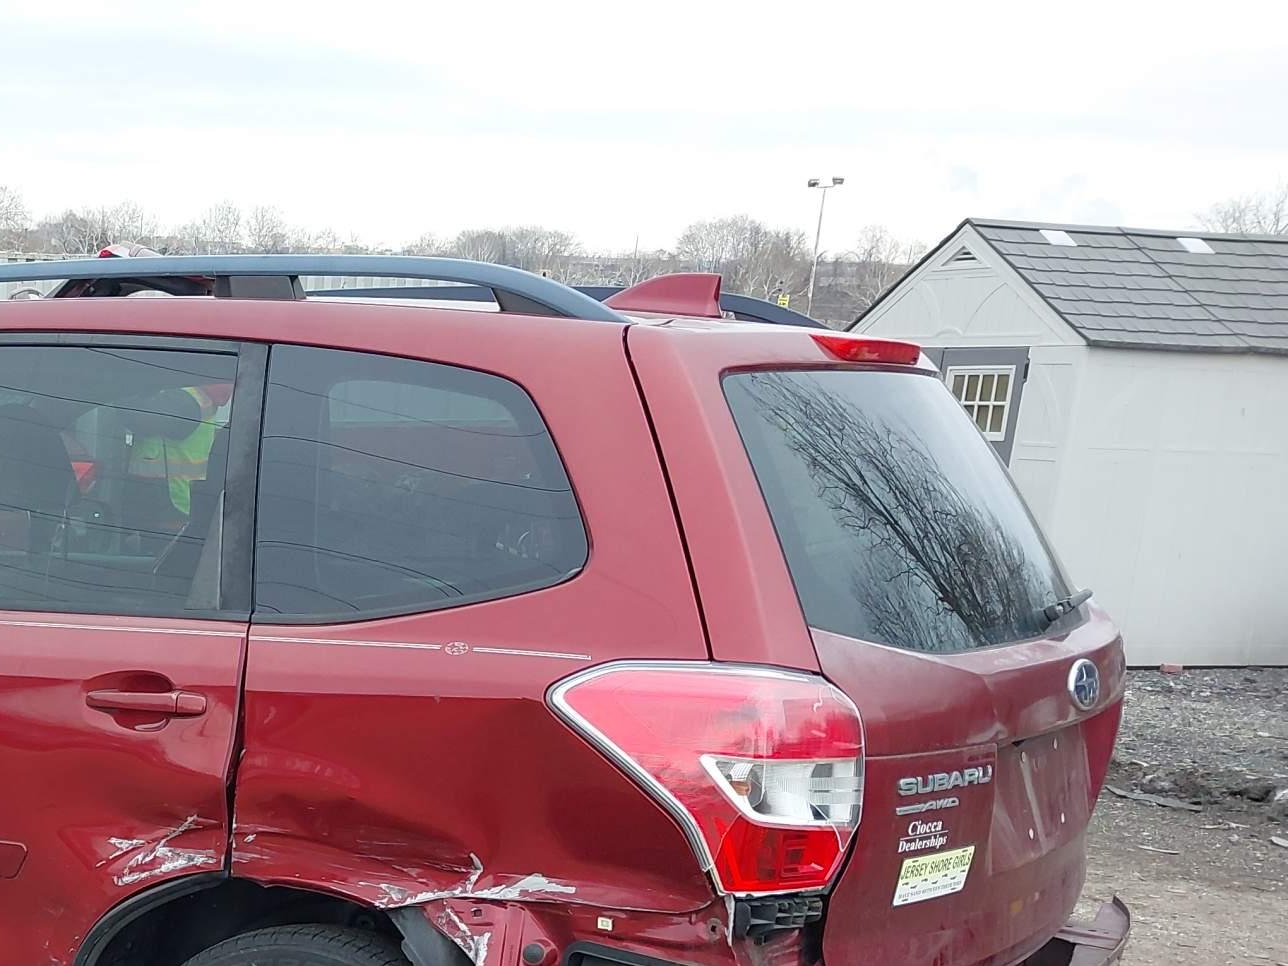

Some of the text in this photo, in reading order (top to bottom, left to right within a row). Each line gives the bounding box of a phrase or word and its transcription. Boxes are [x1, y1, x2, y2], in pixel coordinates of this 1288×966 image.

[897, 764, 992, 796] SUBARU
[908, 820, 943, 836] Ciocca
[898, 834, 948, 853] Dealerships
[901, 852, 972, 880] JERSEY SHORE GIRLS
